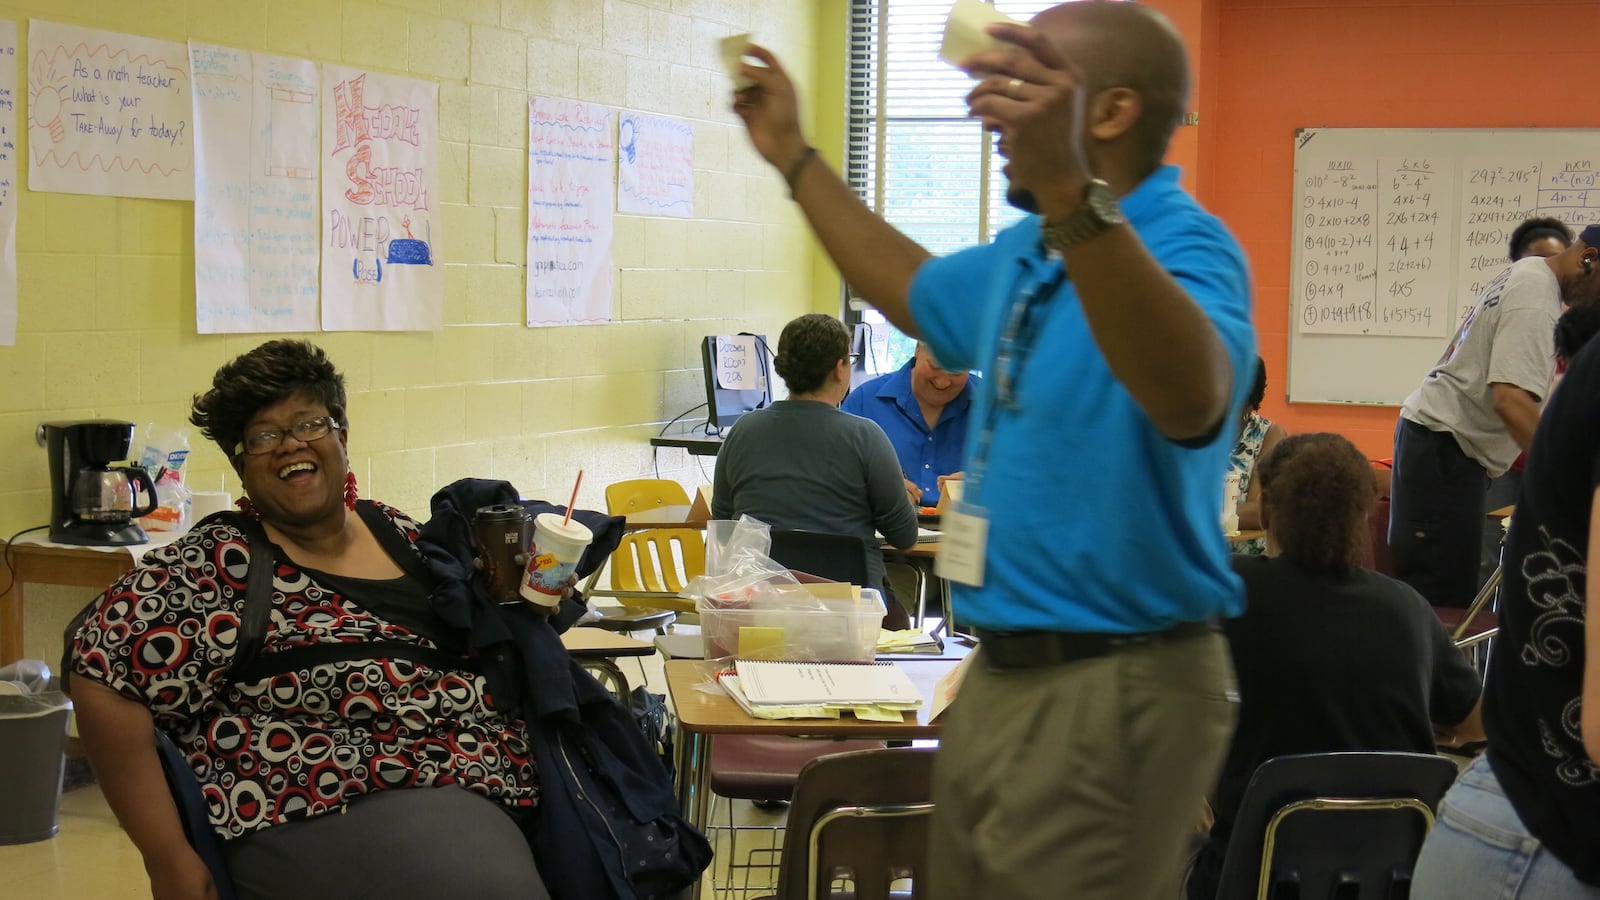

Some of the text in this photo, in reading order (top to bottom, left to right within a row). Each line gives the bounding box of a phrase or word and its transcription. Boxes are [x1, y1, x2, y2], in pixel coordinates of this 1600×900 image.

[73, 58, 88, 78] As
[94, 69, 102, 80] a
[107, 65, 129, 82] math
[137, 64, 180, 94] teacher,
[73, 87, 140, 112] What is your
[131, 118, 142, 137] for
[149, 115, 185, 147] today?
[345, 144, 428, 211] SCHOOL
